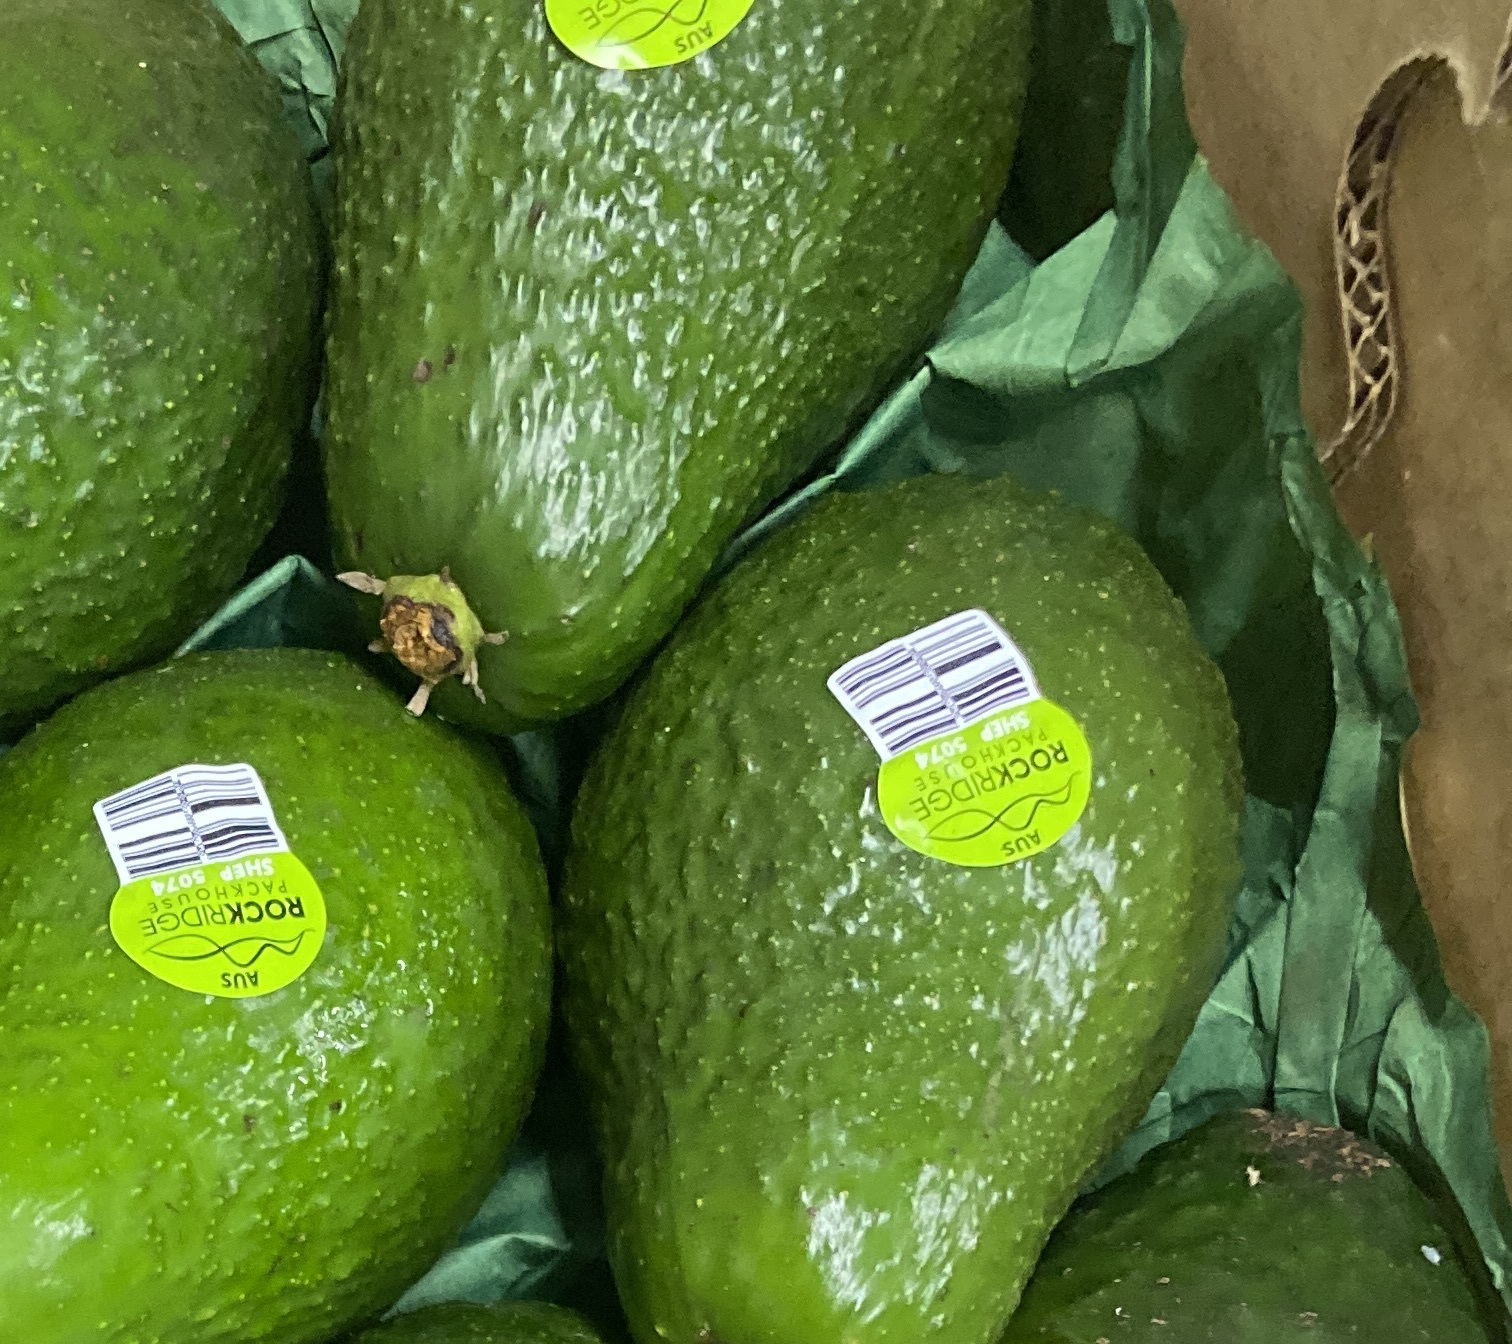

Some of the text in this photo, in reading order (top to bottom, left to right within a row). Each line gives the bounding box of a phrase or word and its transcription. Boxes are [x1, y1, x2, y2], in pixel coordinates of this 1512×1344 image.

[673, 21, 715, 53] AUS
[914, 710, 1031, 770] SHEP 5074
[913, 728, 1047, 792] PACKHOUSE
[909, 741, 1069, 821] ROCKRIDGE
[1001, 829, 1041, 856] AUS
[150, 857, 275, 896] SHEP 5074
[147, 880, 287, 914] PACKHOUSE
[138, 897, 305, 937] ROCKRIDGE
[221, 971, 258, 988] AUS
